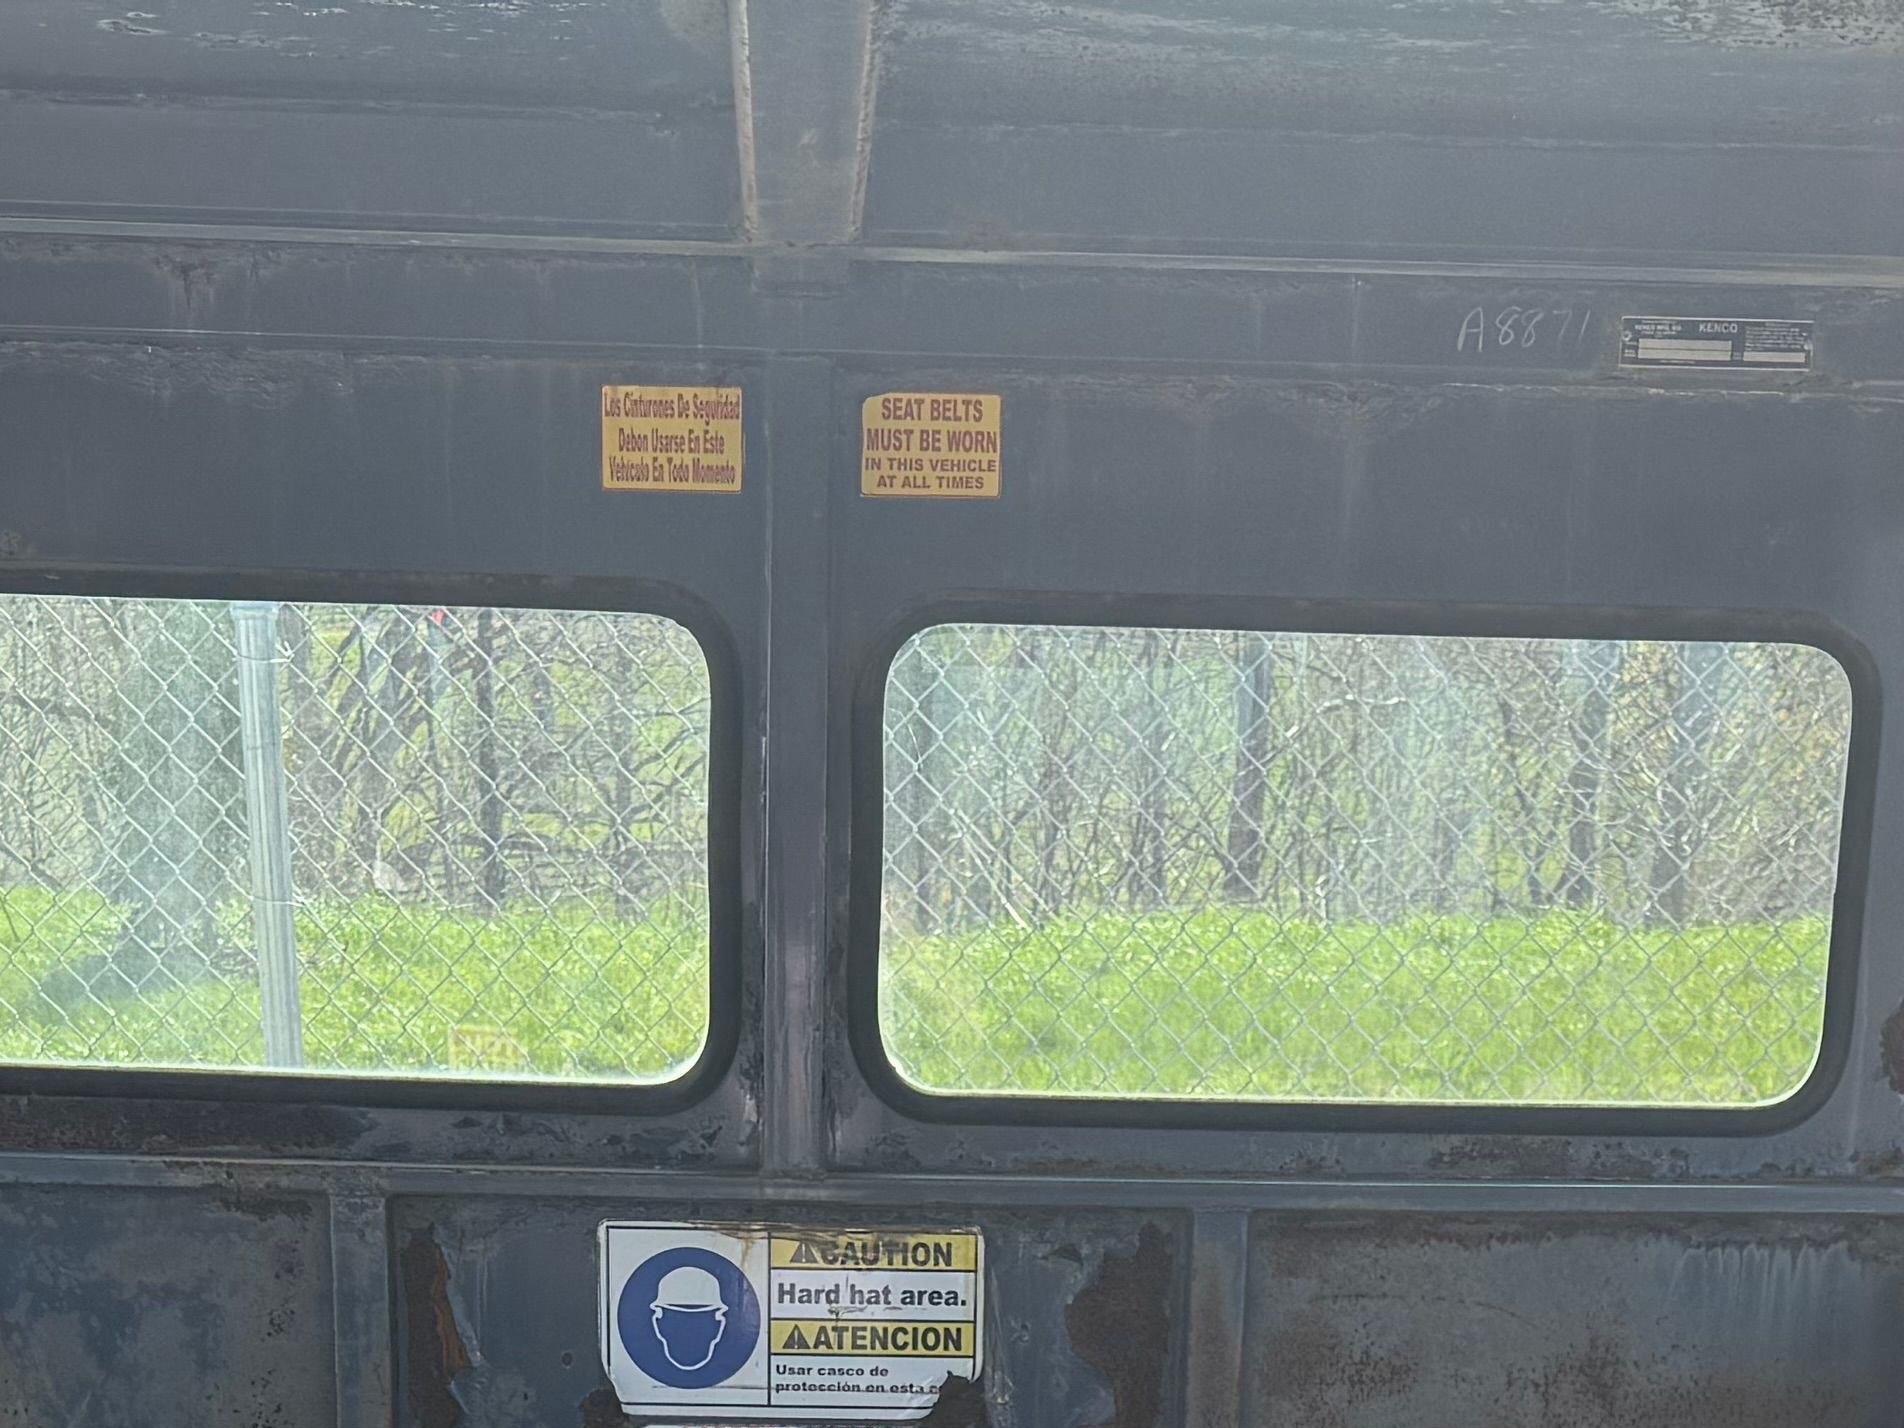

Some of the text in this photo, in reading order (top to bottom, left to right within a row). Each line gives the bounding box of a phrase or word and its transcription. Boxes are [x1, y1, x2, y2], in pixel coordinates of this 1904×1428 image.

[1457, 305, 1591, 353] A8871
[1698, 322, 1738, 334] KENCO
[604, 392, 621, 418] Los
[677, 393, 690, 419] De
[692, 392, 740, 426] Seguridad
[881, 397, 983, 422] SEAT BELTS
[651, 427, 685, 453] Usarse
[688, 428, 701, 454] En
[703, 429, 725, 455] Este
[866, 428, 998, 453] MUST BE WORN
[652, 456, 664, 482] En
[667, 457, 689, 483] Todo
[692, 457, 736, 484] Momento
[865, 457, 997, 472] IN THIS VEHICLE
[876, 475, 984, 489] AT ALL TIMES
[777, 1283, 967, 1306] Hard hat area.
[812, 1325, 962, 1352] ATENCION
[776, 1364, 889, 1377] Usar casco de
[775, 1380, 861, 1394] protección
[865, 1383, 885, 1393] en
